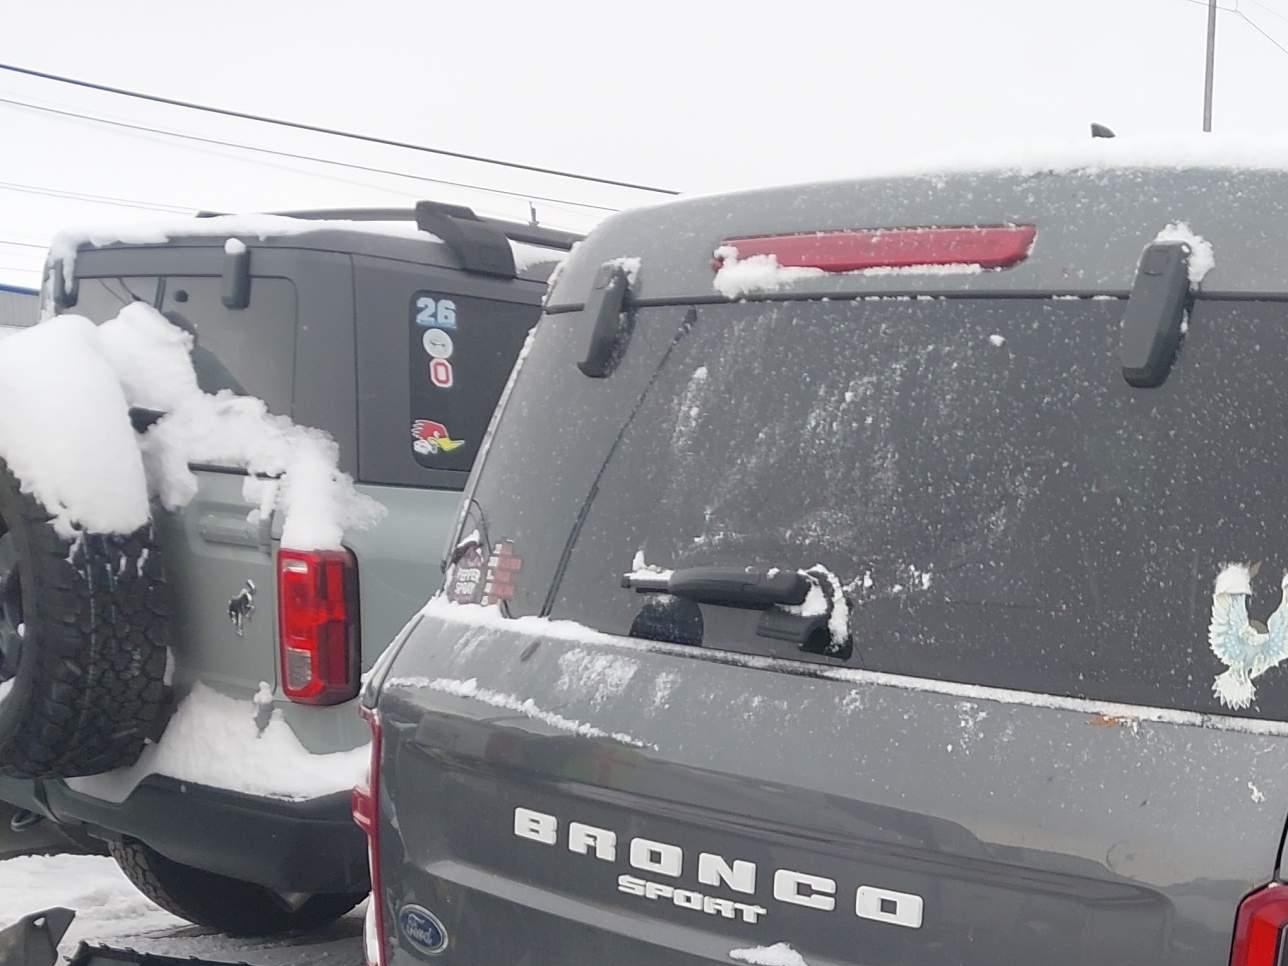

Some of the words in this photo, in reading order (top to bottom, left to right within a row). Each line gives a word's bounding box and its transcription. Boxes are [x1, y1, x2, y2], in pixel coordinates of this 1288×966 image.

[416, 297, 456, 328] 26
[514, 807, 924, 928] BRONCO
[618, 875, 767, 924] SPORT
